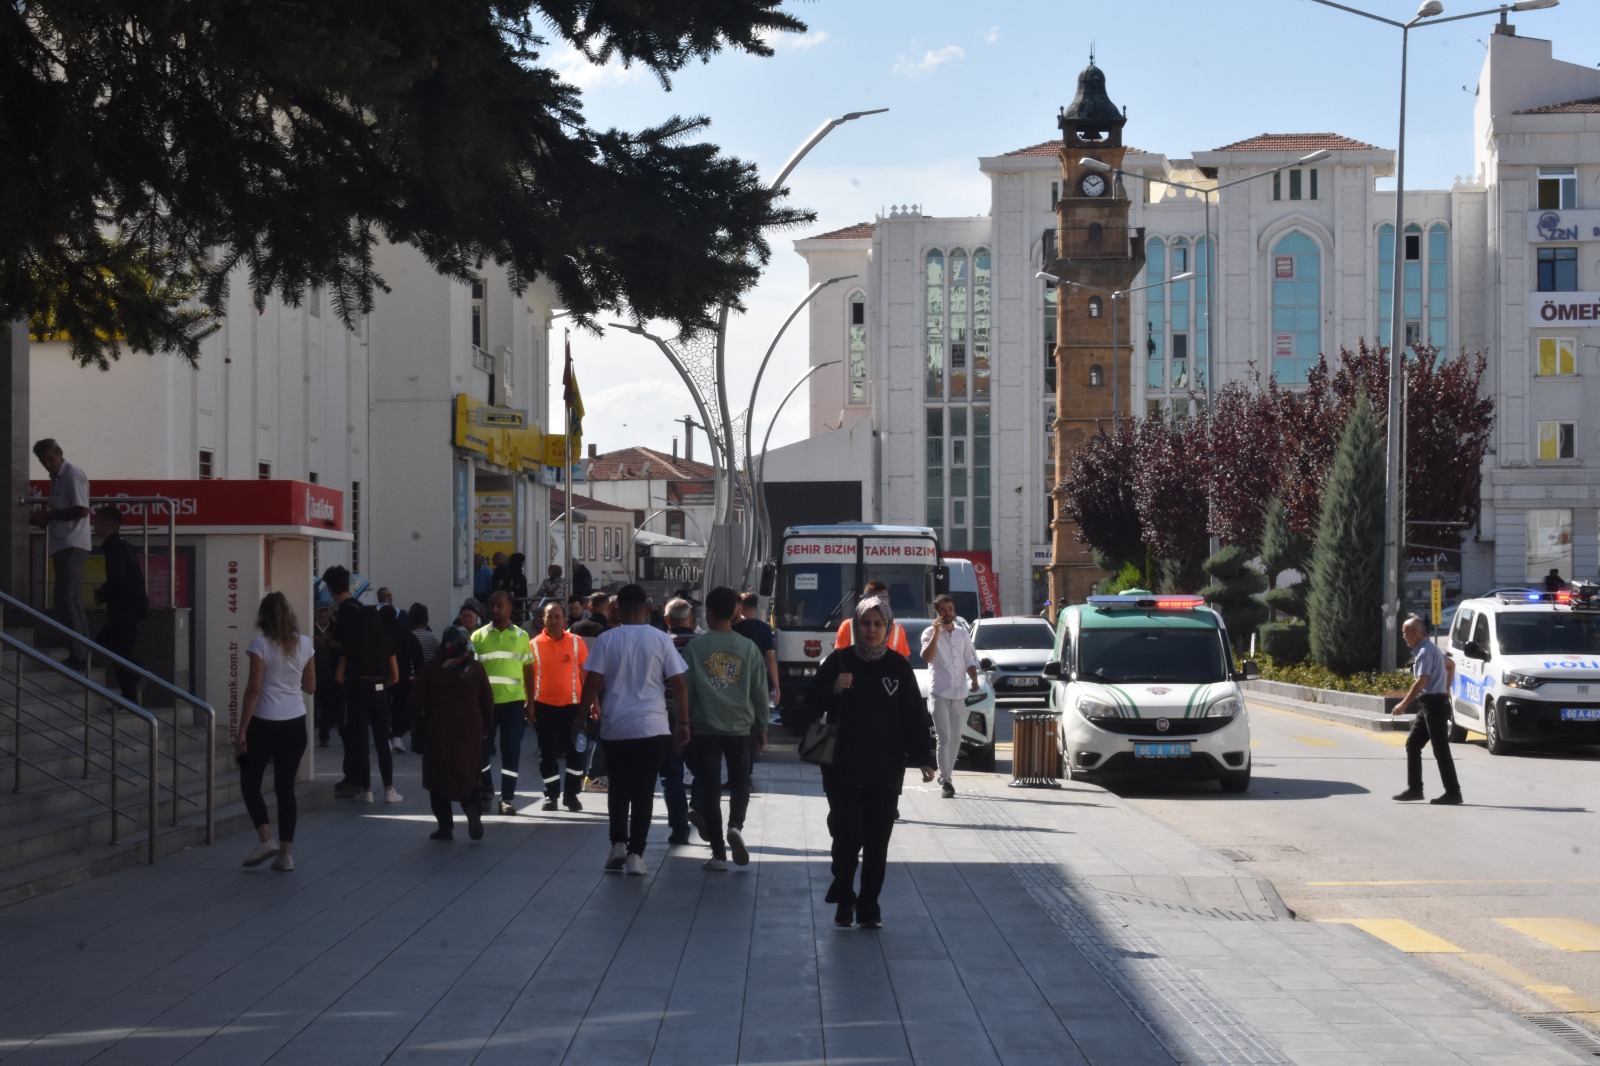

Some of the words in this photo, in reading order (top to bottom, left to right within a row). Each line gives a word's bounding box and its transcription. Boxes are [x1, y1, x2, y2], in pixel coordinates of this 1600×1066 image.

[864, 546, 901, 556] TAKIM
[663, 566, 699, 583] AKGOLD
[228, 593, 238, 613] 444
[1566, 710, 1577, 718] 66
[1578, 710, 1585, 718] A
[1140, 745, 1150, 754] 66
[1158, 745, 1163, 754] A
